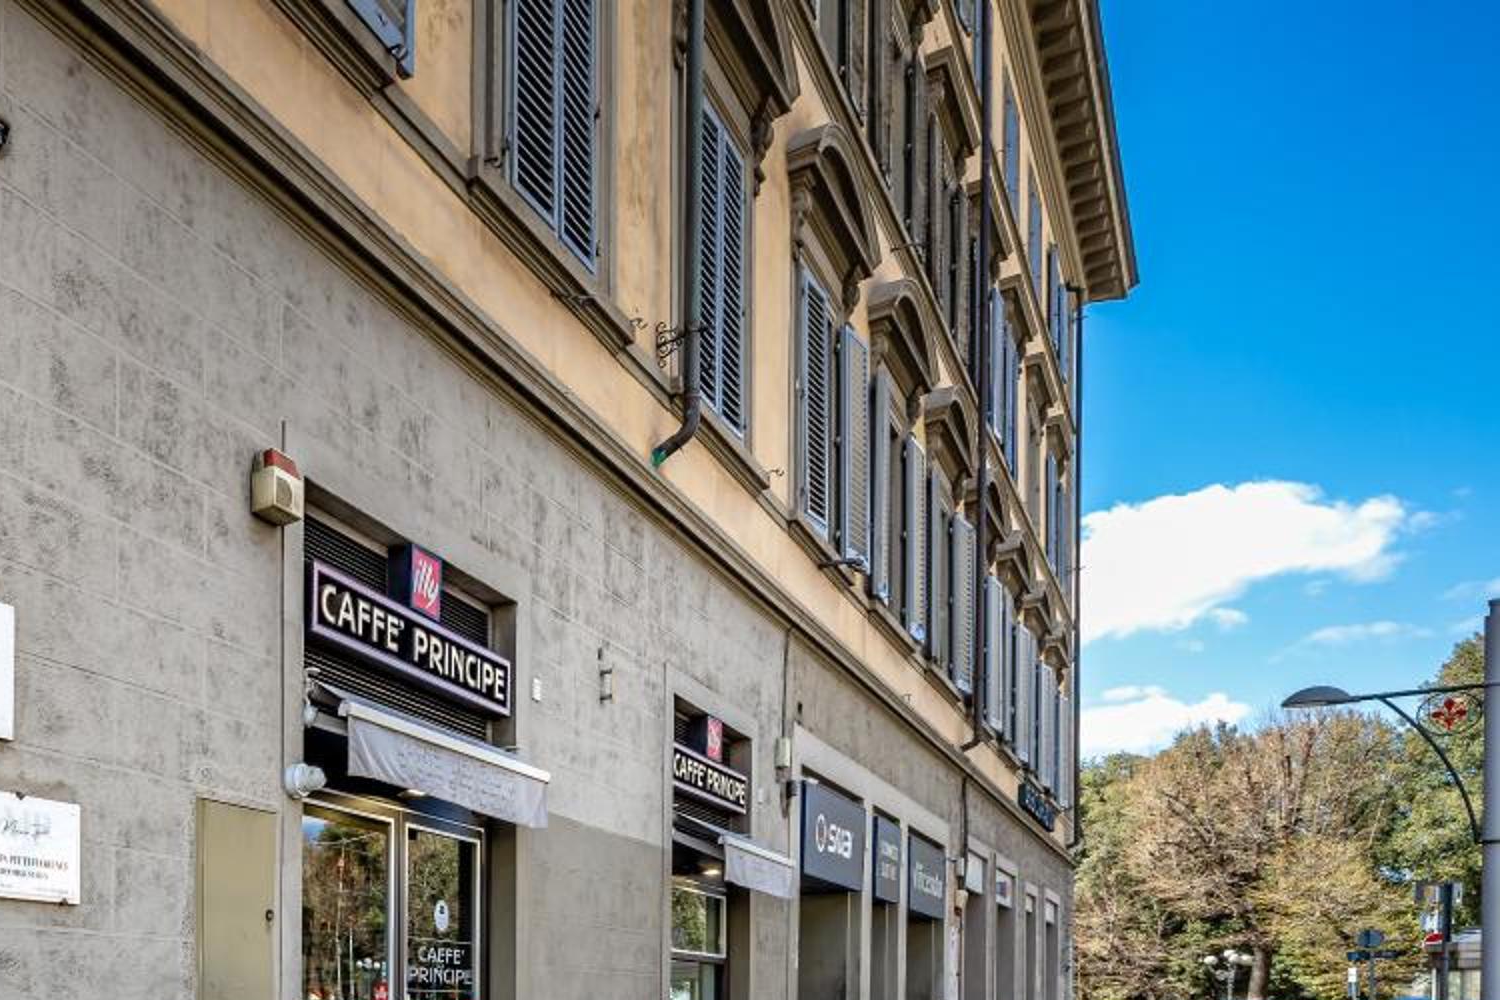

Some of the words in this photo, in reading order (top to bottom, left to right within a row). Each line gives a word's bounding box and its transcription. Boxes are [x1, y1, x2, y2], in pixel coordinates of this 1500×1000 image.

[414, 560, 439, 609] illy
[321, 583, 405, 652] CAFFE'
[413, 627, 505, 700] PRINCIPE
[707, 767, 746, 805] PRINCIPE
[409, 966, 473, 985] PRINCIPE
